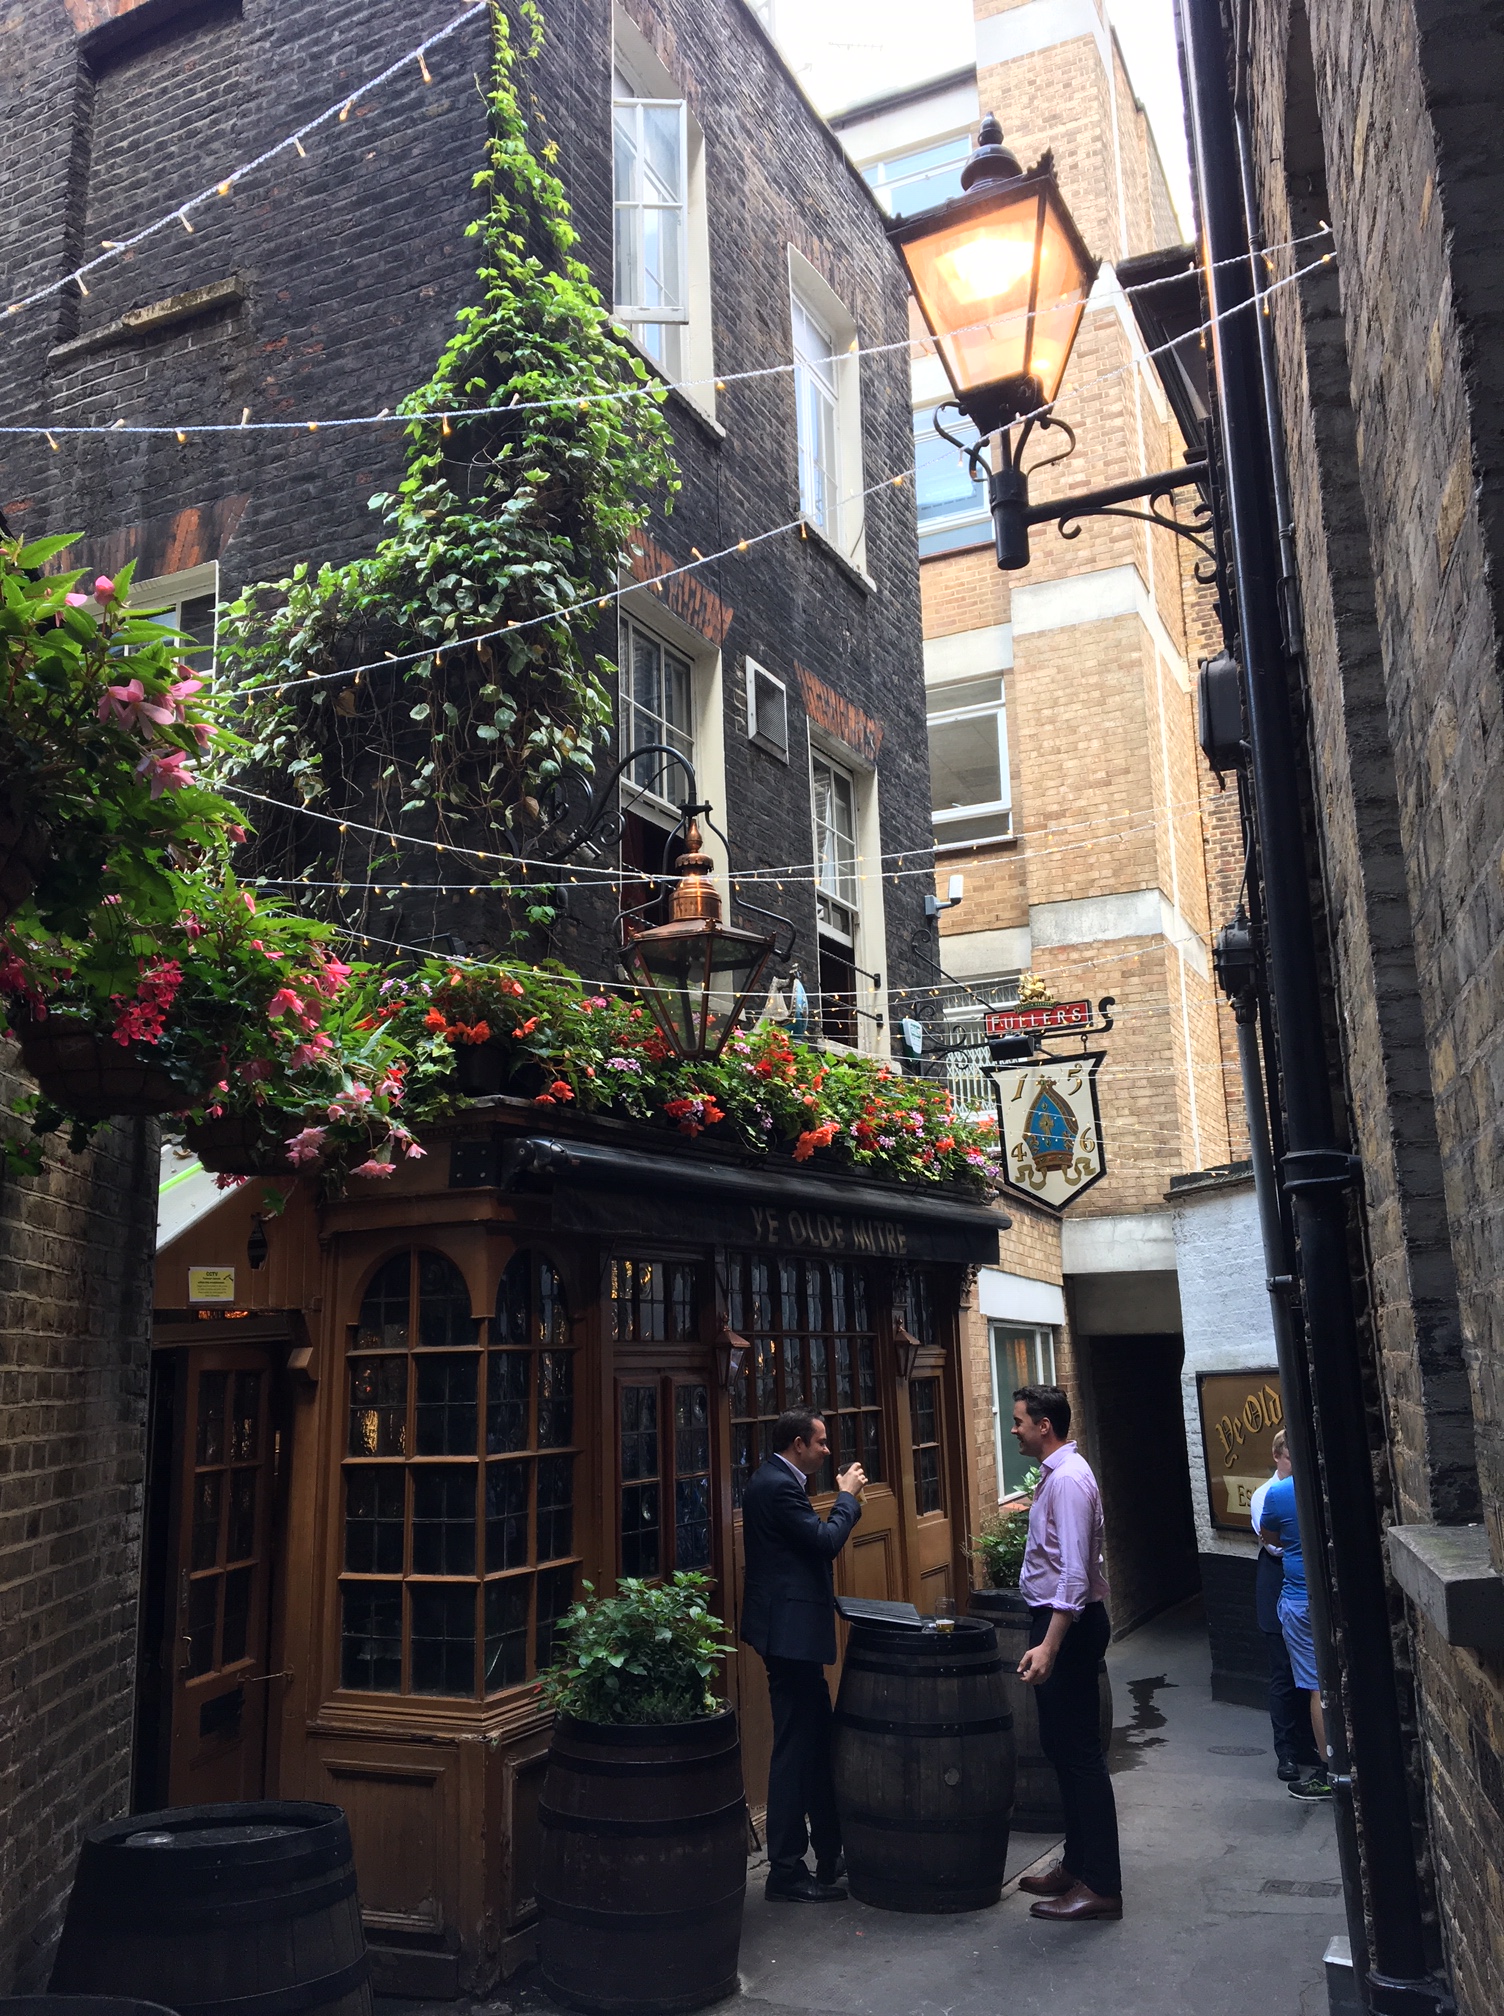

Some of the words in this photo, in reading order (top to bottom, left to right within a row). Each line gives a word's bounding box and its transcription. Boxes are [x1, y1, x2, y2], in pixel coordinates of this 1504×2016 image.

[1010, 1073, 1029, 1102] 1
[1066, 1062, 1083, 1096] 5
[1010, 1142, 1028, 1163] 4
[1079, 1126, 1096, 1154] 6
[750, 1205, 779, 1243] YE
[787, 1210, 846, 1249] OLDE
[852, 1217, 908, 1255] MITRE
[1215, 1415, 1246, 1469] Ye
[1242, 1384, 1284, 1434] Old
